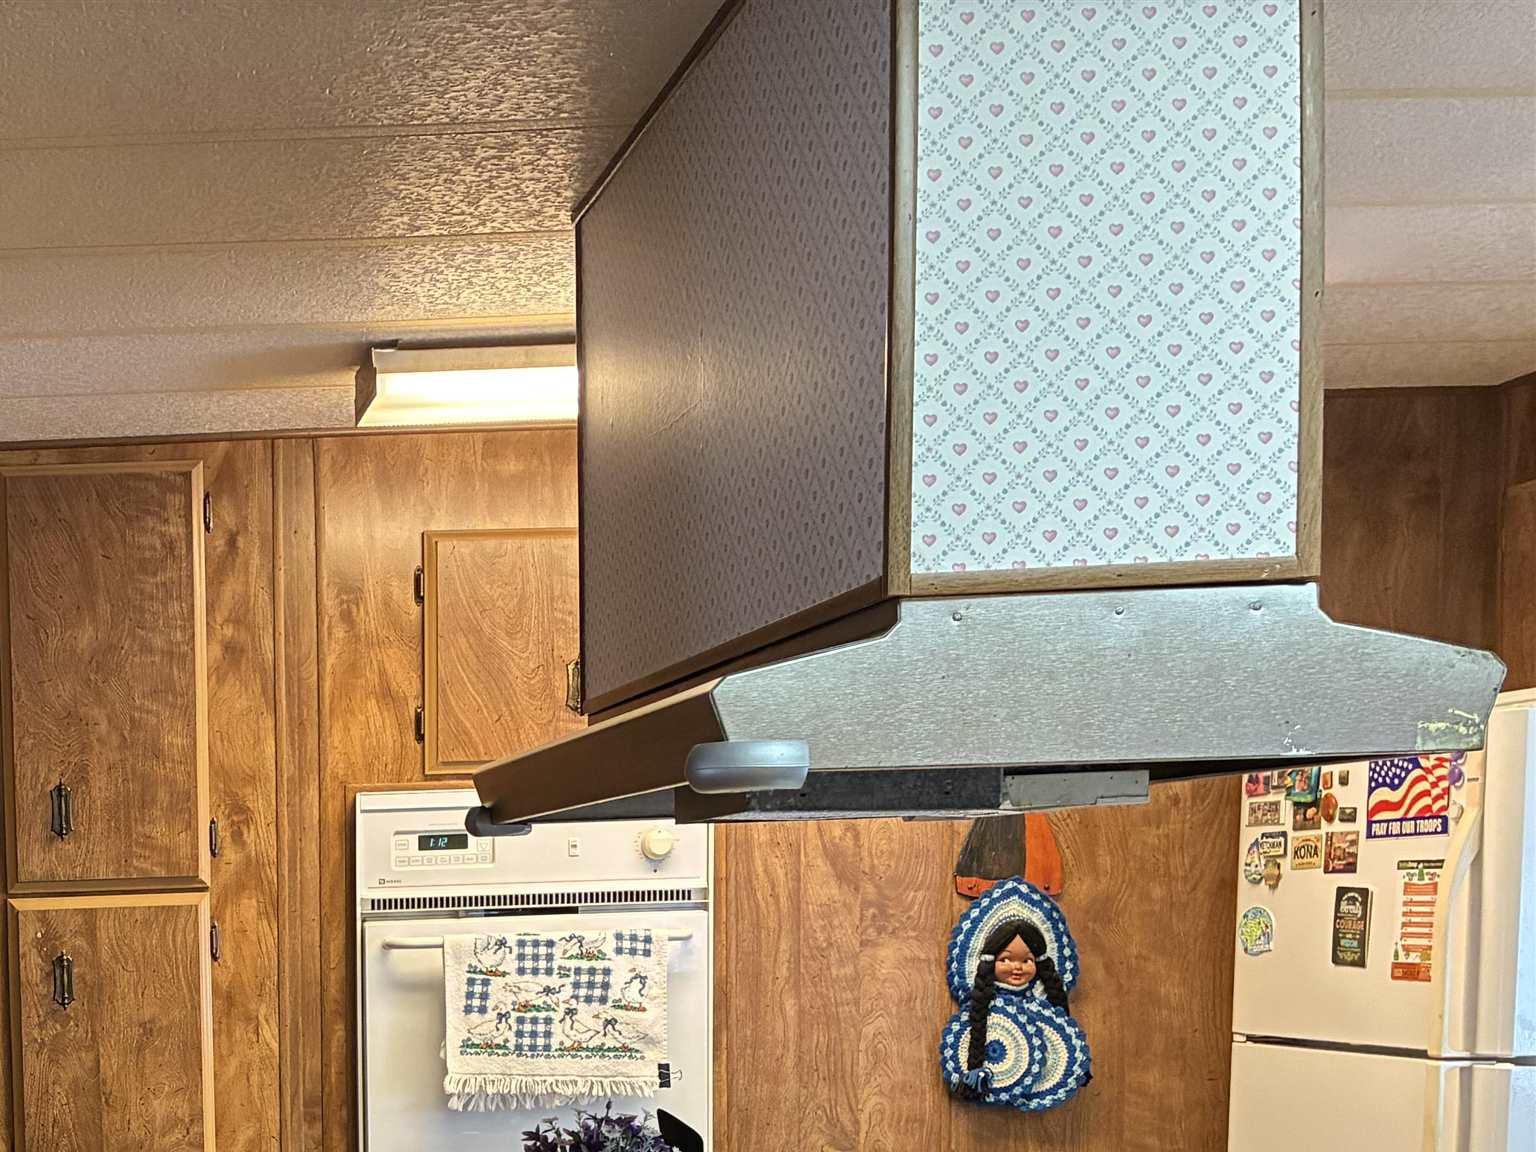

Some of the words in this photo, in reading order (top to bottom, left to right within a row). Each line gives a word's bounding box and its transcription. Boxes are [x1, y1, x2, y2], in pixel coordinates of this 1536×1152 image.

[1371, 822, 1388, 837] PRAY
[1388, 821, 1401, 835] FOR
[1401, 820, 1415, 834] OUR
[1416, 818, 1442, 833] TROOPS
[1293, 843, 1319, 860] KONA
